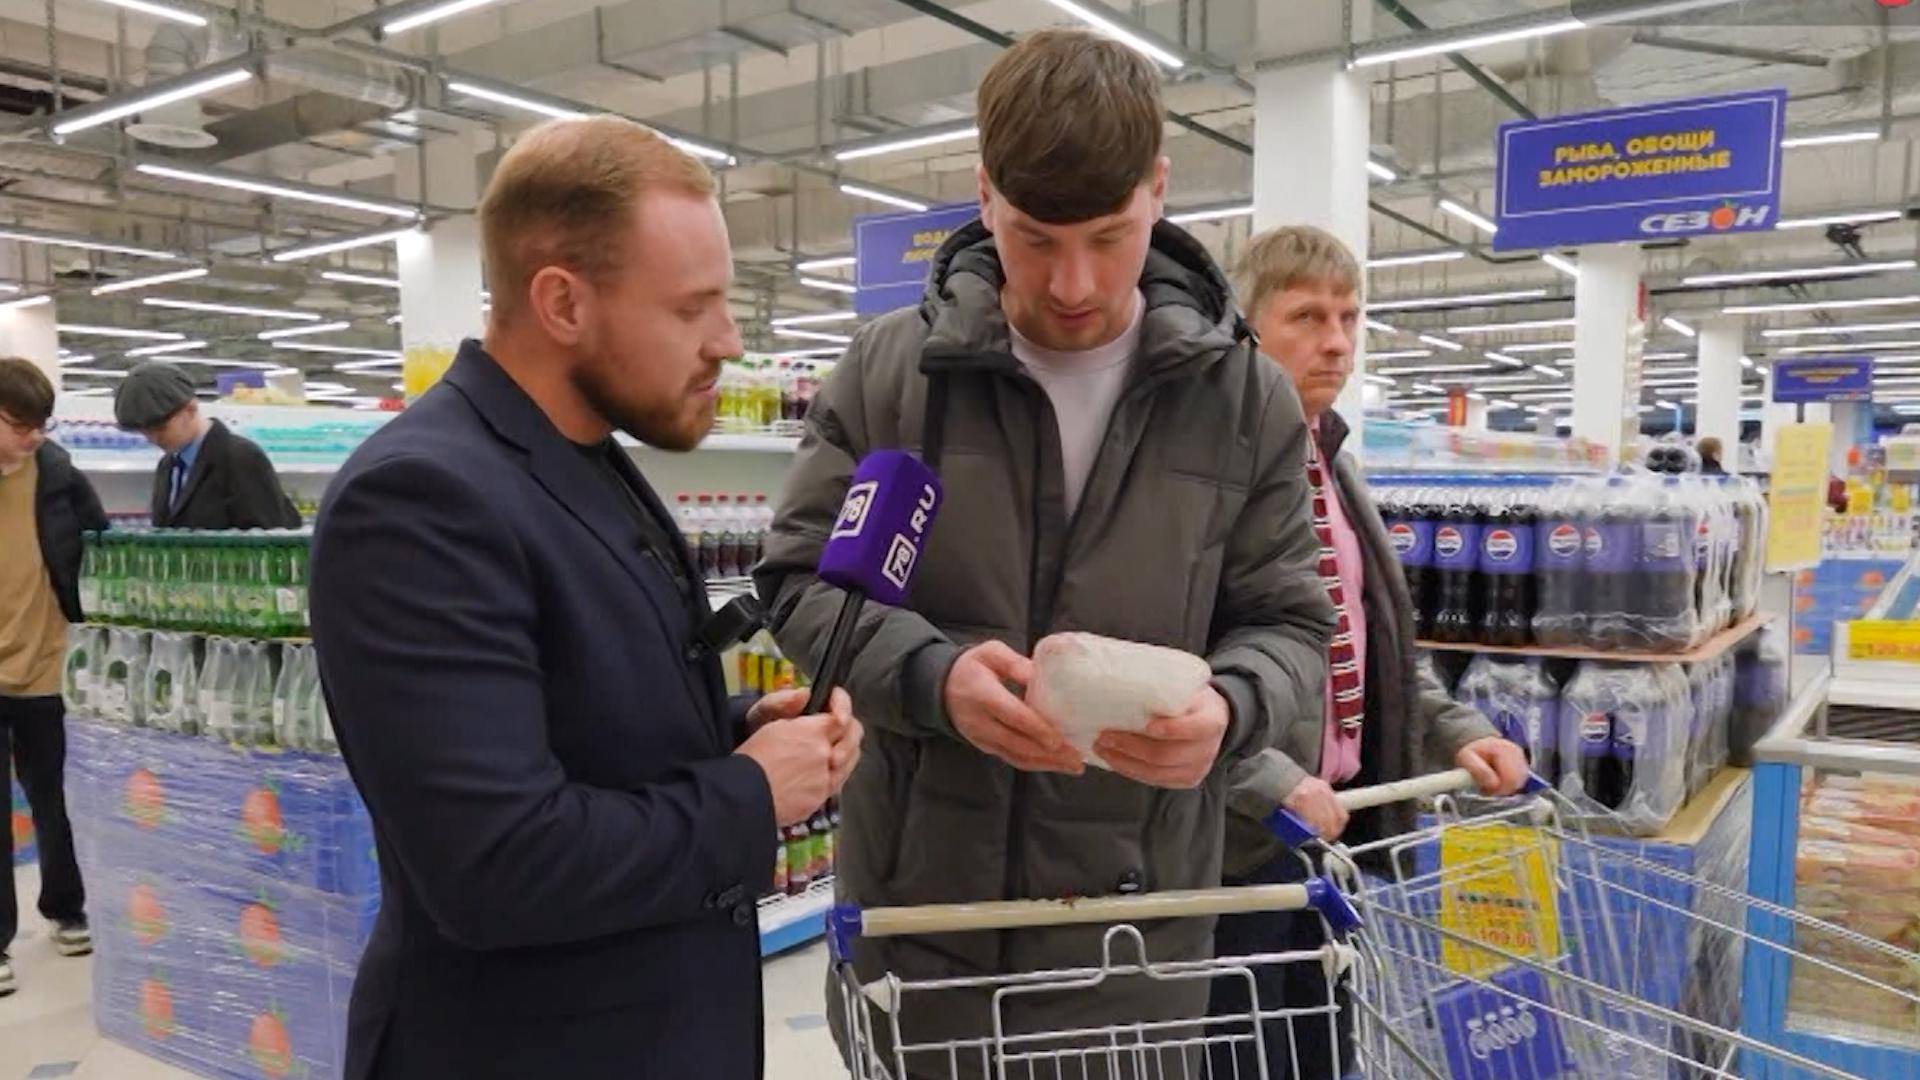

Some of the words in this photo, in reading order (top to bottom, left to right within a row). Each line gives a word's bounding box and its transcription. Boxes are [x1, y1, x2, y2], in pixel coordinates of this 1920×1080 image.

[1555, 142, 1621, 162] РЫБА,
[1626, 131, 1715, 154] ОВОЩИ
[1540, 151, 1730, 187] ЗАМОРОЖЕННЫЕ
[1640, 203, 1770, 232] СЕЗОН
